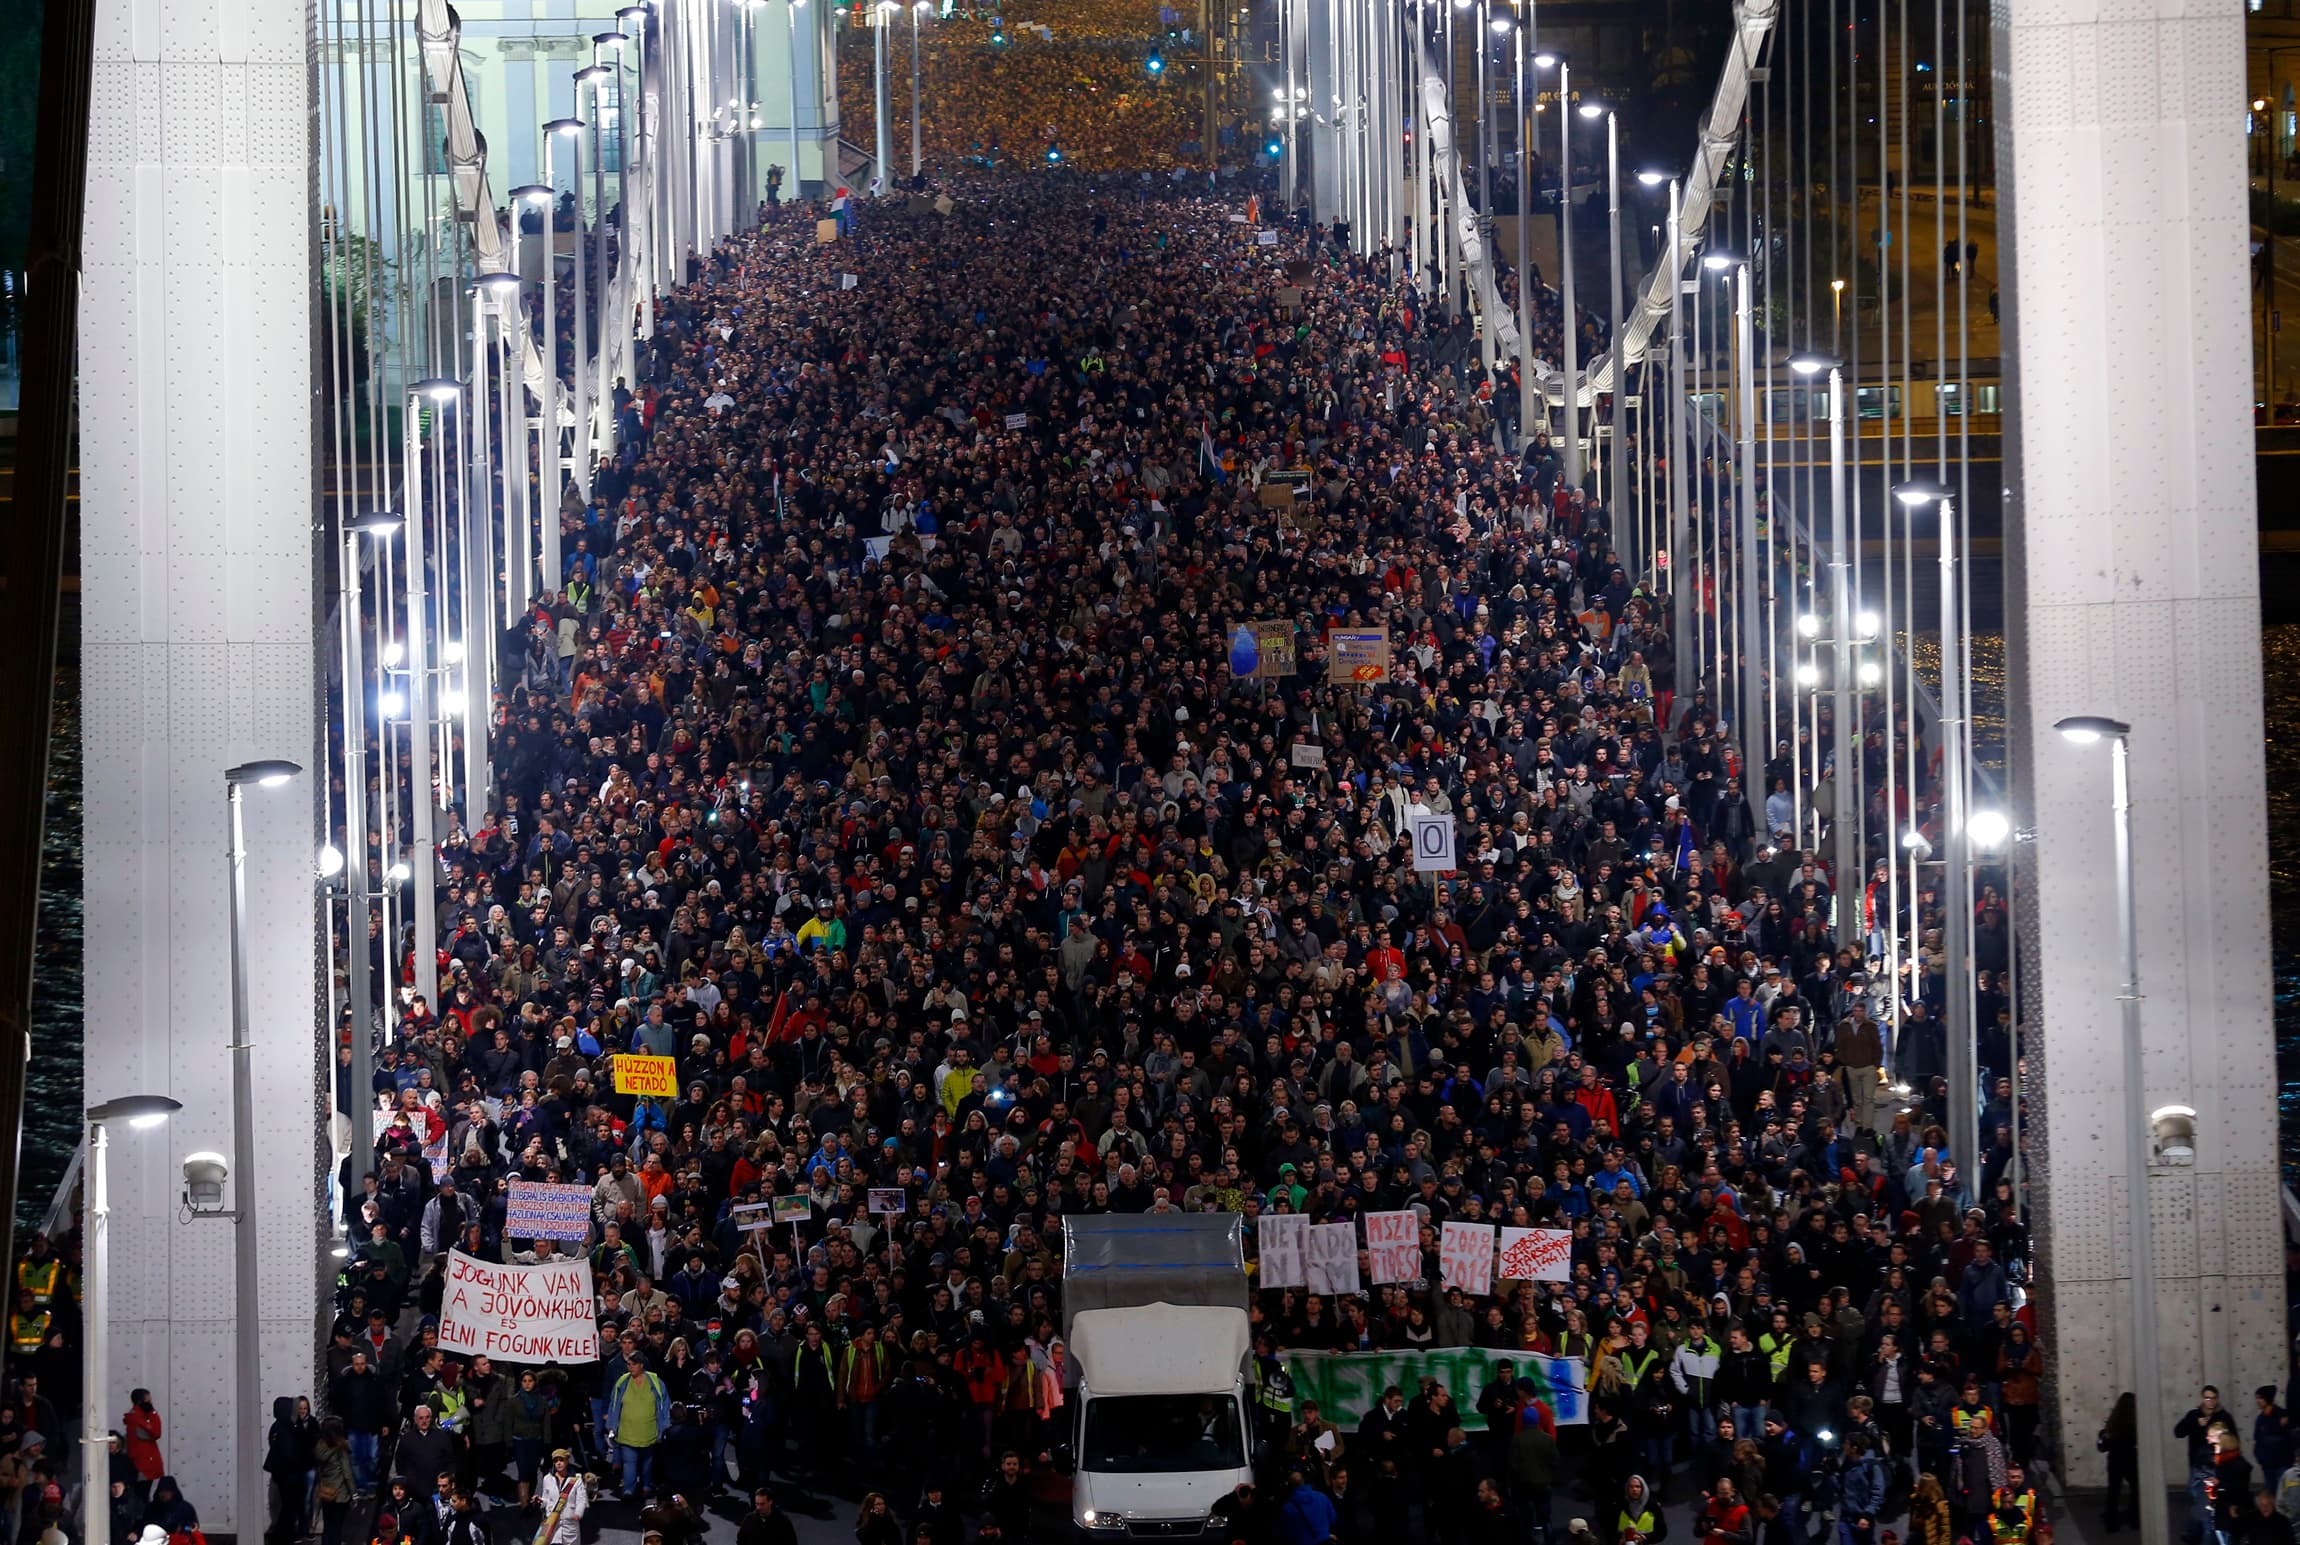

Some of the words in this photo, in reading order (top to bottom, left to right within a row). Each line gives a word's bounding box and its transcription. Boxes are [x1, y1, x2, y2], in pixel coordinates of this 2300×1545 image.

[668, 1062, 675, 1076] A
[1368, 1214, 1416, 1242] MSZP
[1444, 1228, 1491, 1258] 2008
[452, 1258, 530, 1294] JOGUNK
[543, 1271, 581, 1296] VAN
[1441, 1257, 1489, 1293] 2014
[452, 1287, 468, 1310] A
[486, 1330, 554, 1358] FOGUNK
[558, 1333, 598, 1359] VELE!
